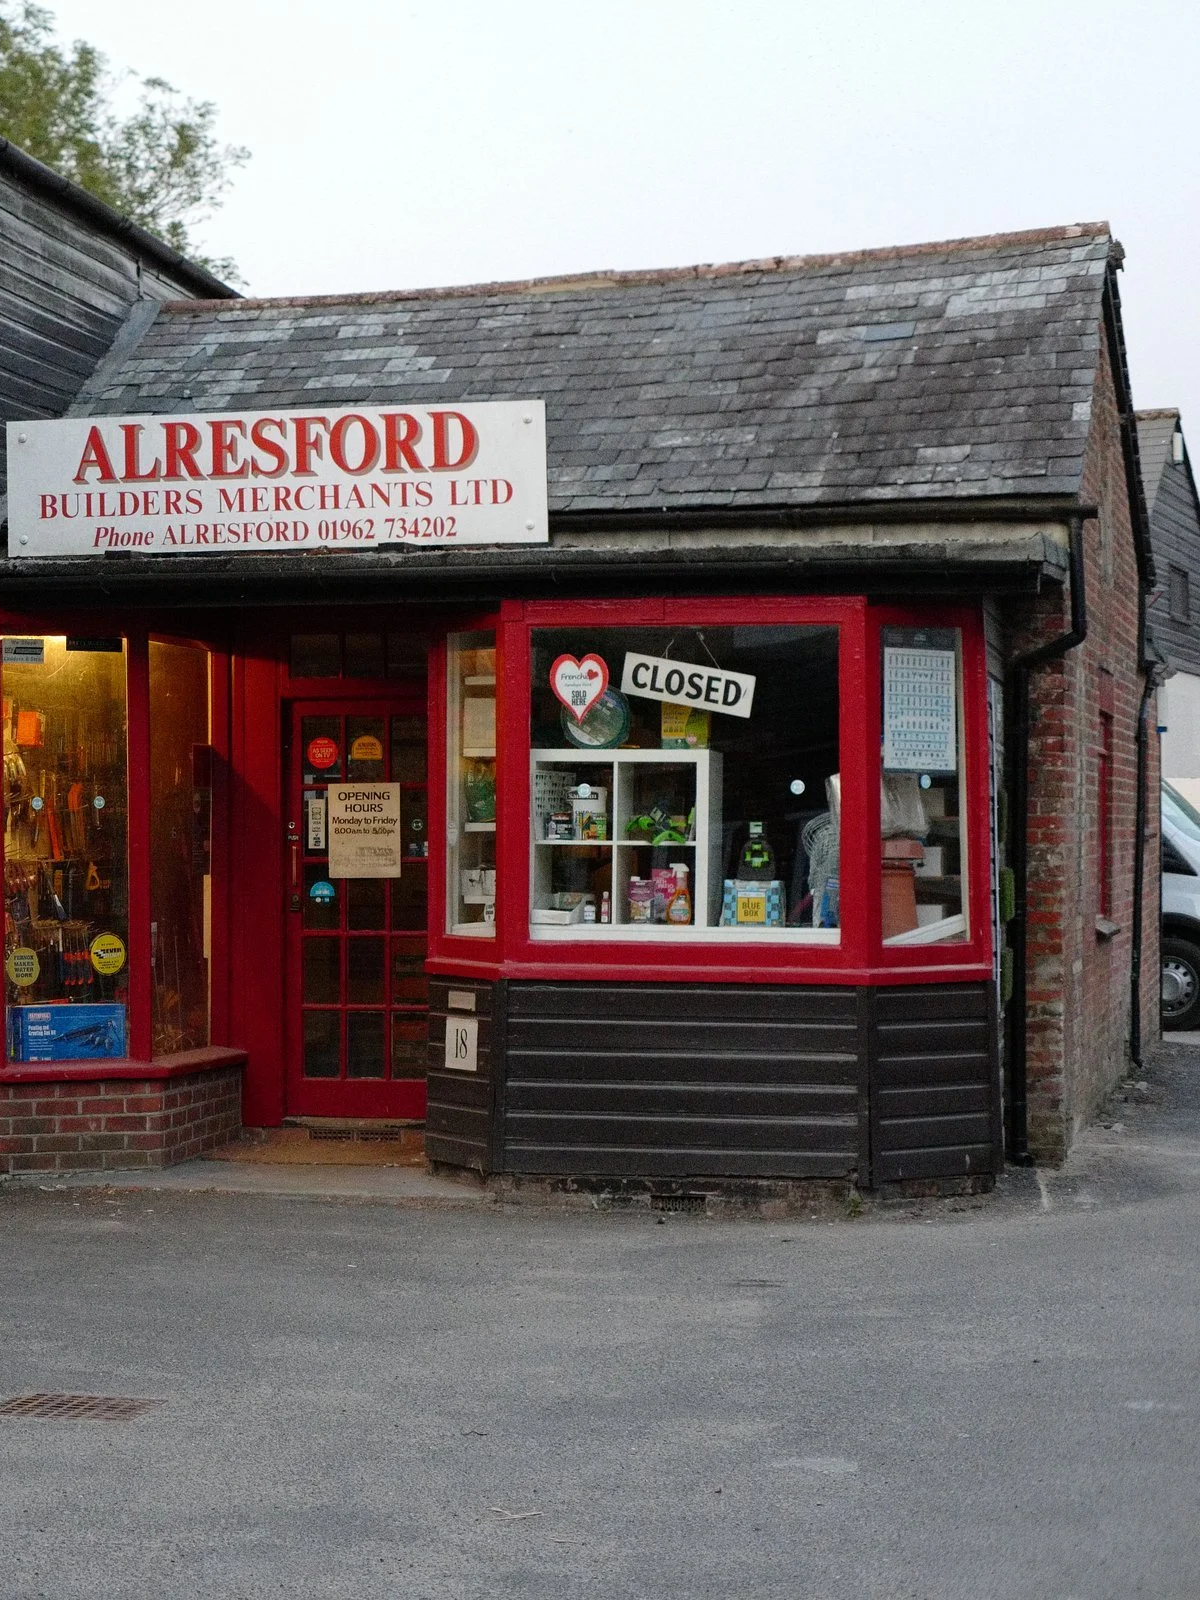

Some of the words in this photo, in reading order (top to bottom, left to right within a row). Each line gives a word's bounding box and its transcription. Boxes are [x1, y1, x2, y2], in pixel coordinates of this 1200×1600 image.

[73, 411, 480, 485] ALRESFORD
[39, 489, 204, 520] BUILDERS
[218, 481, 434, 515] MERCHANTS
[450, 477, 514, 507] LTD
[93, 525, 155, 548] Phone
[162, 520, 310, 546] ALRESFORD
[318, 518, 376, 540] 01962
[383, 516, 458, 539] 734202
[631, 662, 742, 707] CLOSED
[572, 690, 587, 698] SOLD
[572, 698, 587, 706] HERE
[338, 791, 390, 801] OPENING
[344, 803, 383, 812] HOURS
[332, 817, 363, 826] Monday
[363, 817, 372, 825] to
[372, 816, 398, 826] Friday
[742, 898, 761, 910] BLUE
[744, 909, 759, 917] BOX
[455, 1028, 468, 1059] 18
